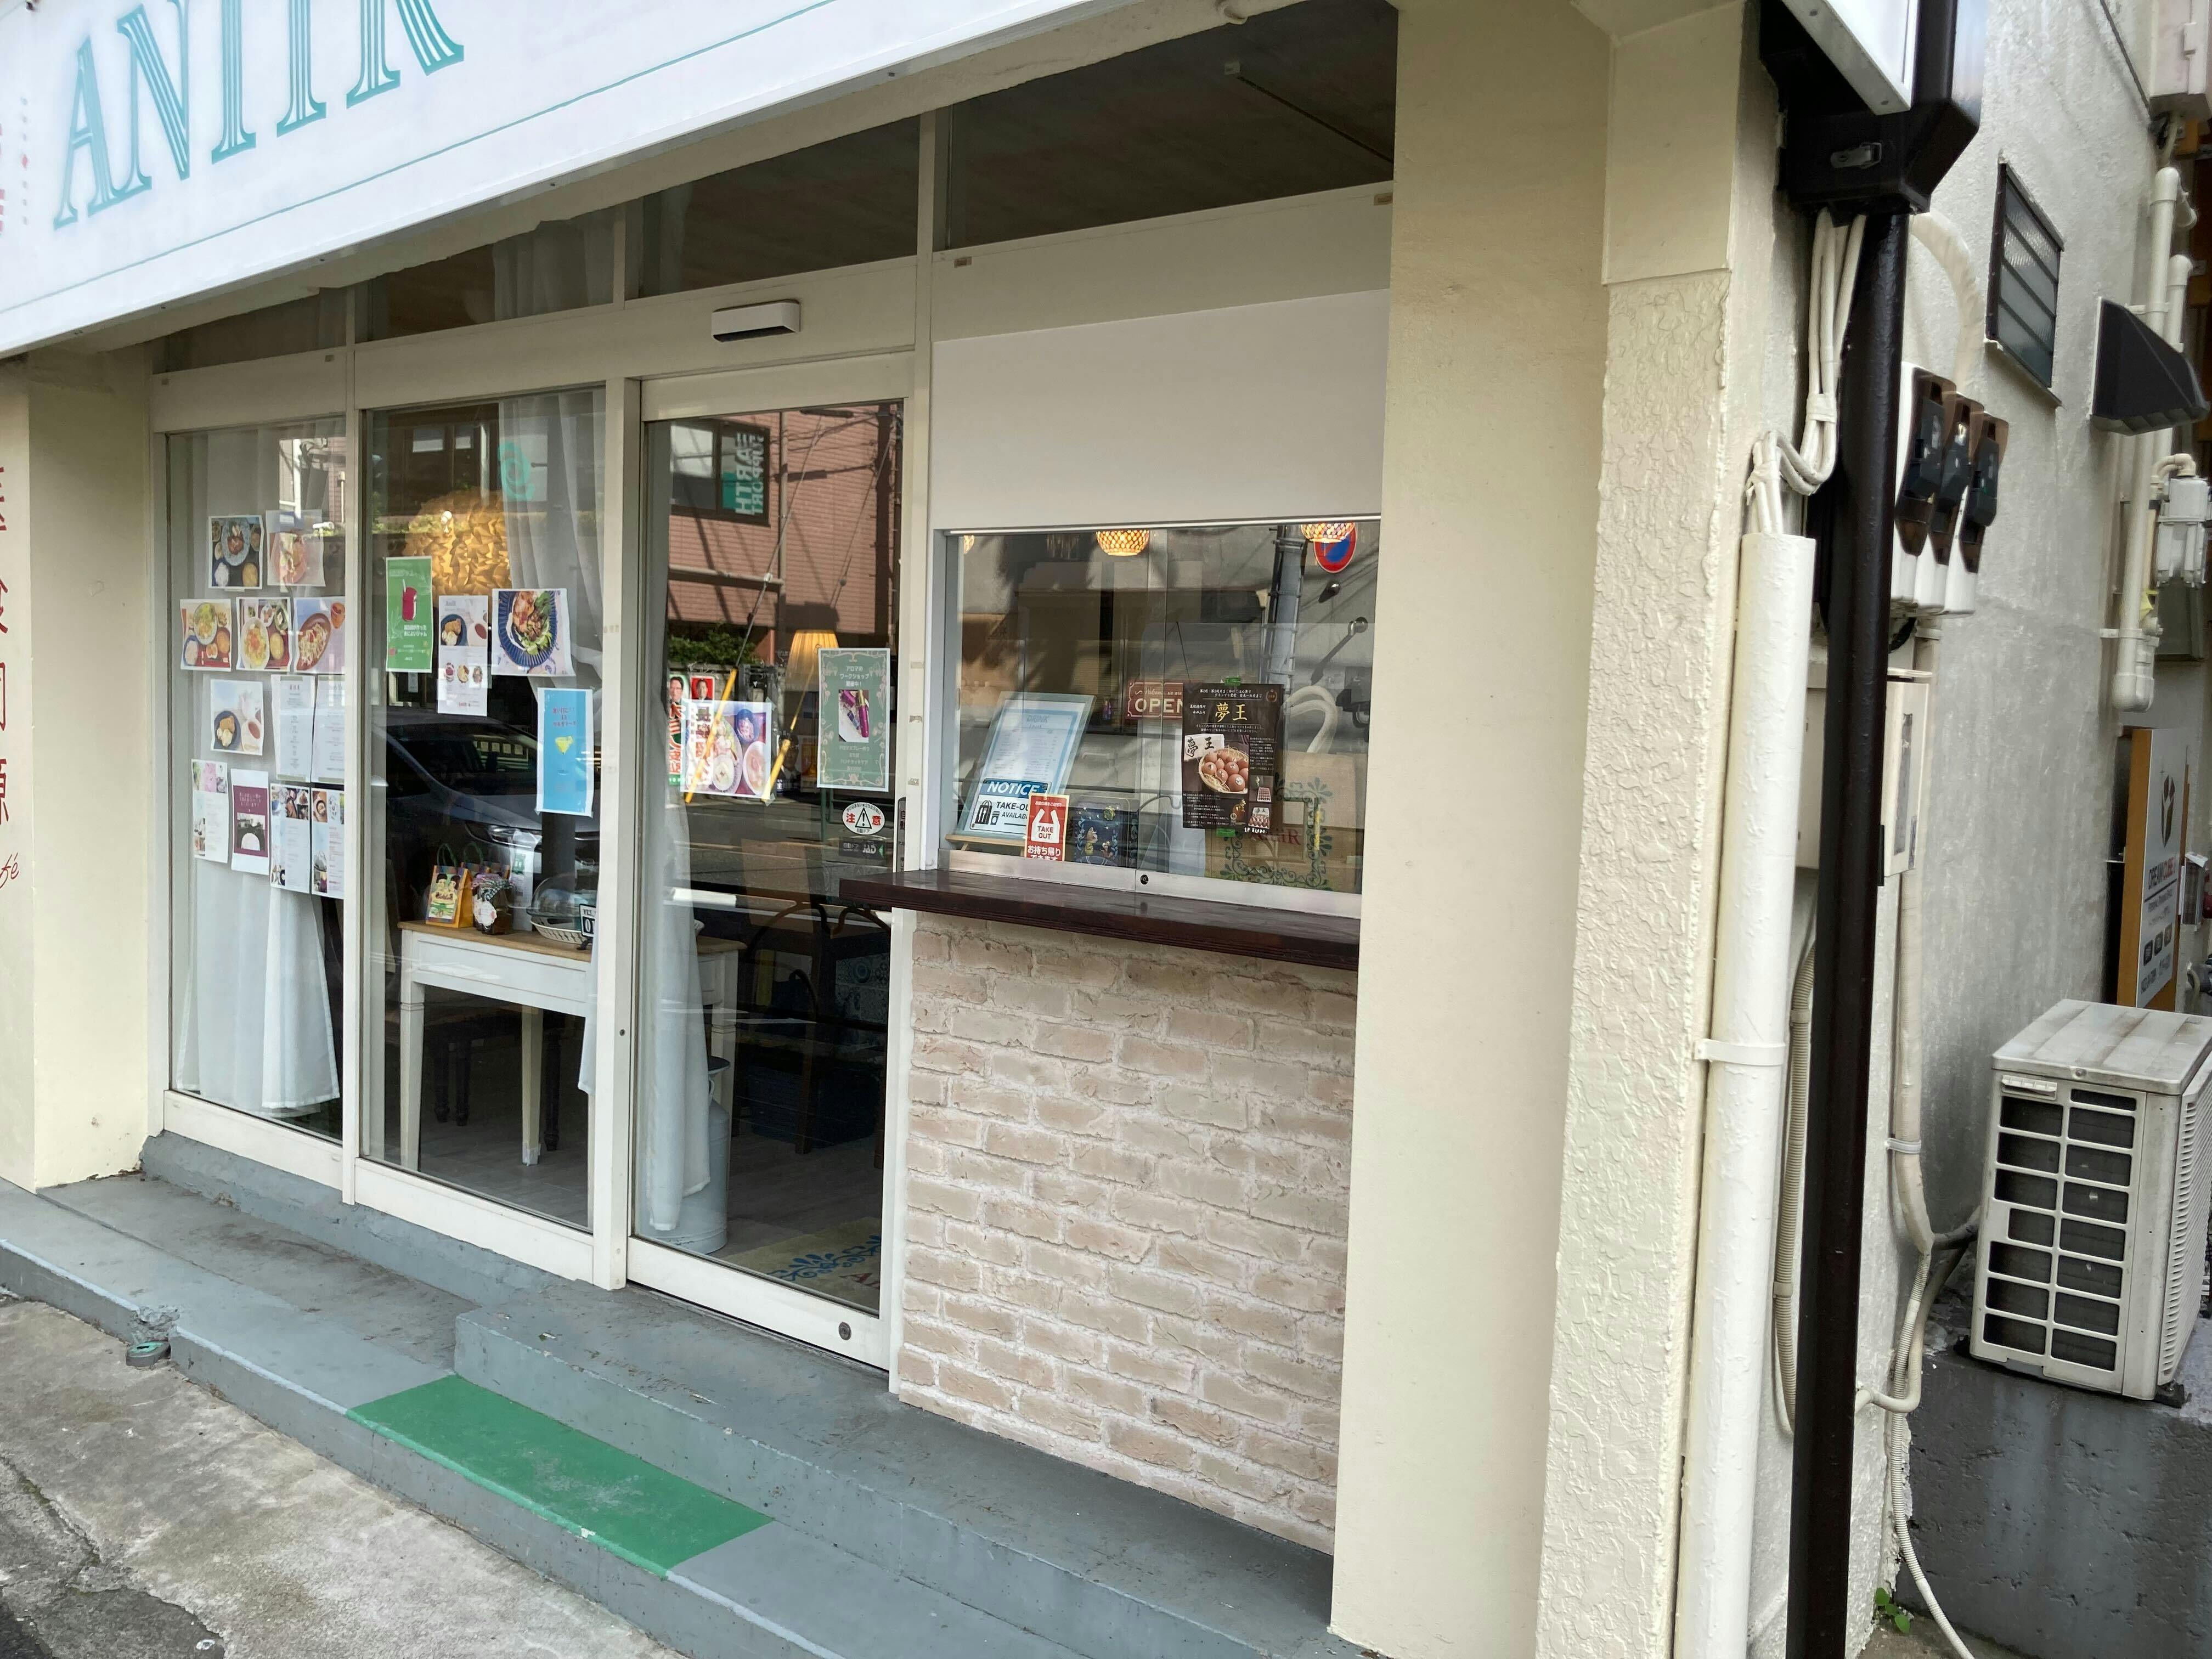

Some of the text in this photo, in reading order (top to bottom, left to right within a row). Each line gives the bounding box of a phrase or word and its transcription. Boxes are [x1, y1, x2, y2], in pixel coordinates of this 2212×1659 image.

[1215, 702, 1248, 723] 夢王
[986, 781, 1041, 795] NOTICE
[996, 801, 1029, 811] TAKE-O
[1027, 845, 1061, 856] お持ち帰り
